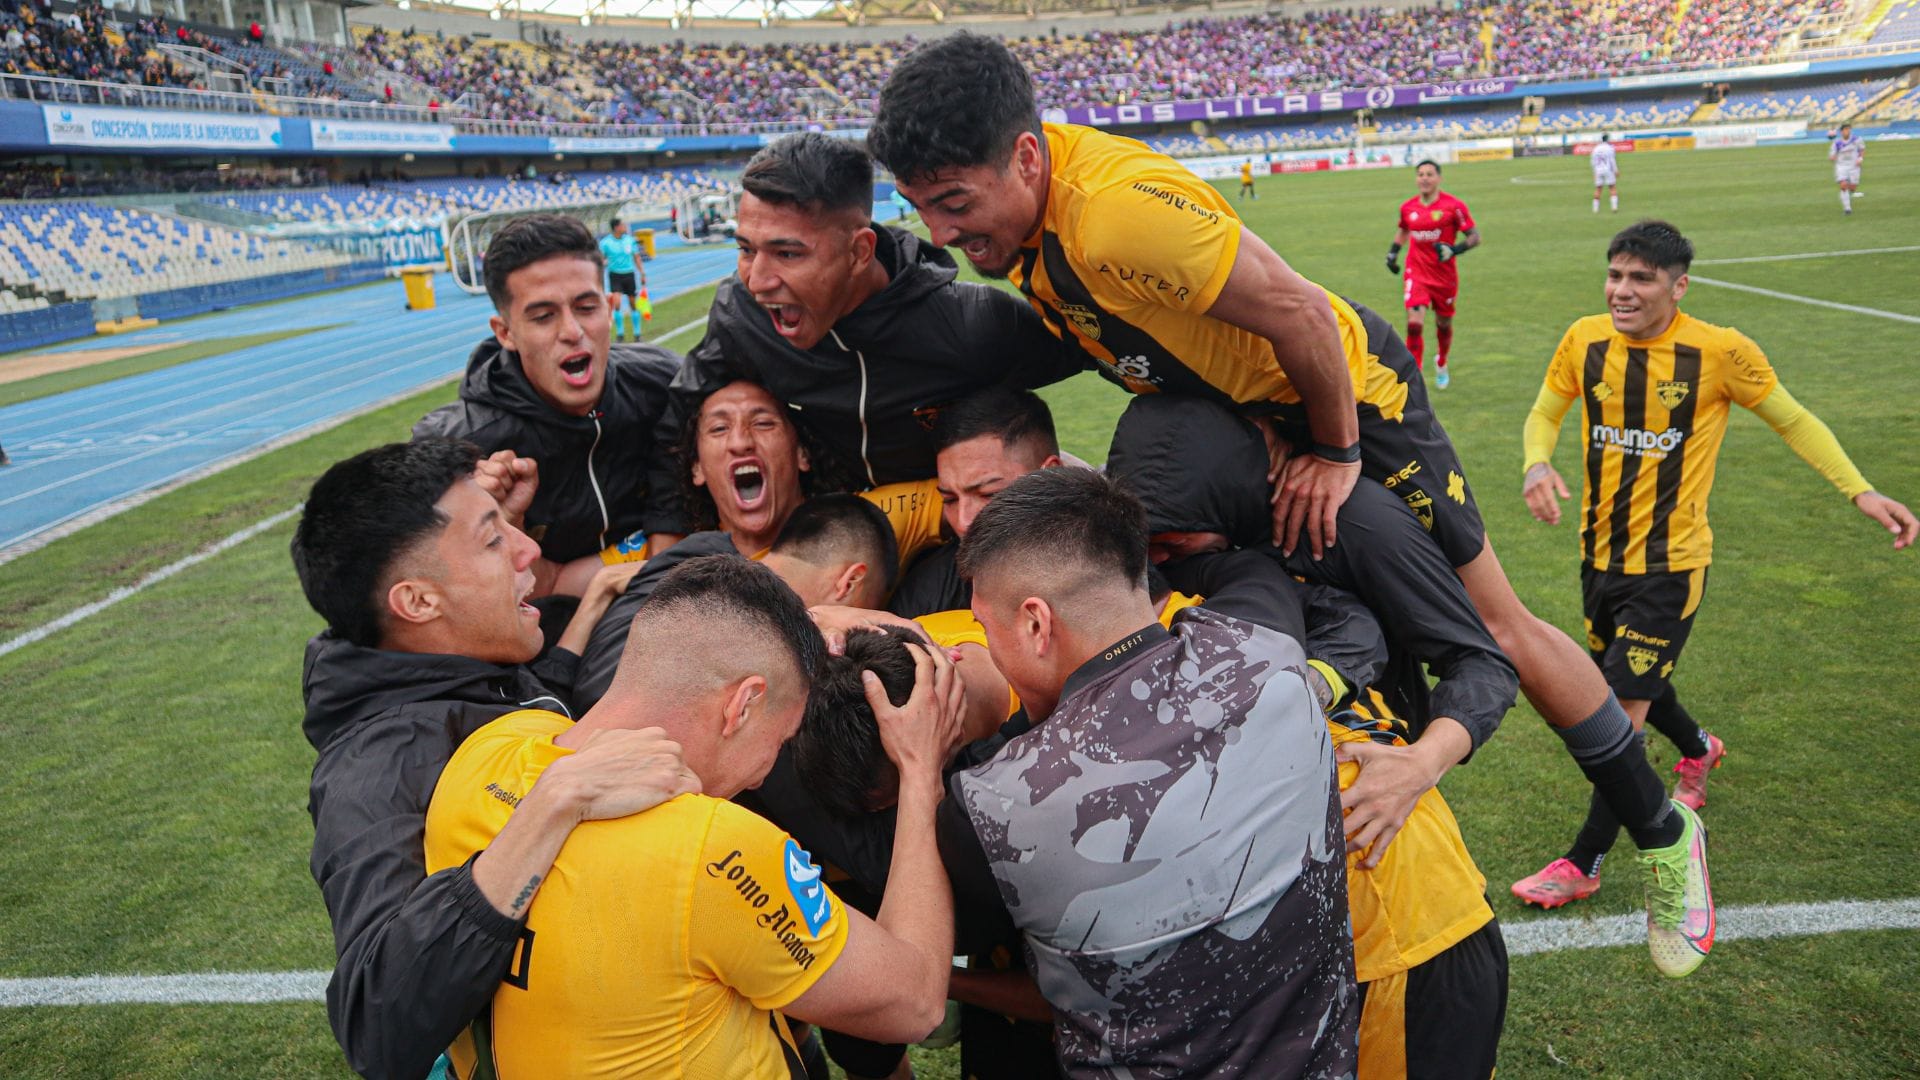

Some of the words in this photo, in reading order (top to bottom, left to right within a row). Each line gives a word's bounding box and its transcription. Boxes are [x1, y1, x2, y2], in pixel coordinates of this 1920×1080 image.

[1088, 104, 1175, 126] LOS
[1205, 91, 1344, 119] LILAS
[151, 122, 181, 139] CIUDAD
[182, 122, 193, 139] DE
[194, 123, 204, 139] LA
[206, 124, 261, 142] INDEPENDENCIA
[1099, 264, 1190, 301] AUTER
[1105, 635, 1143, 661] ONEFIT
[706, 850, 770, 909] Lomo
